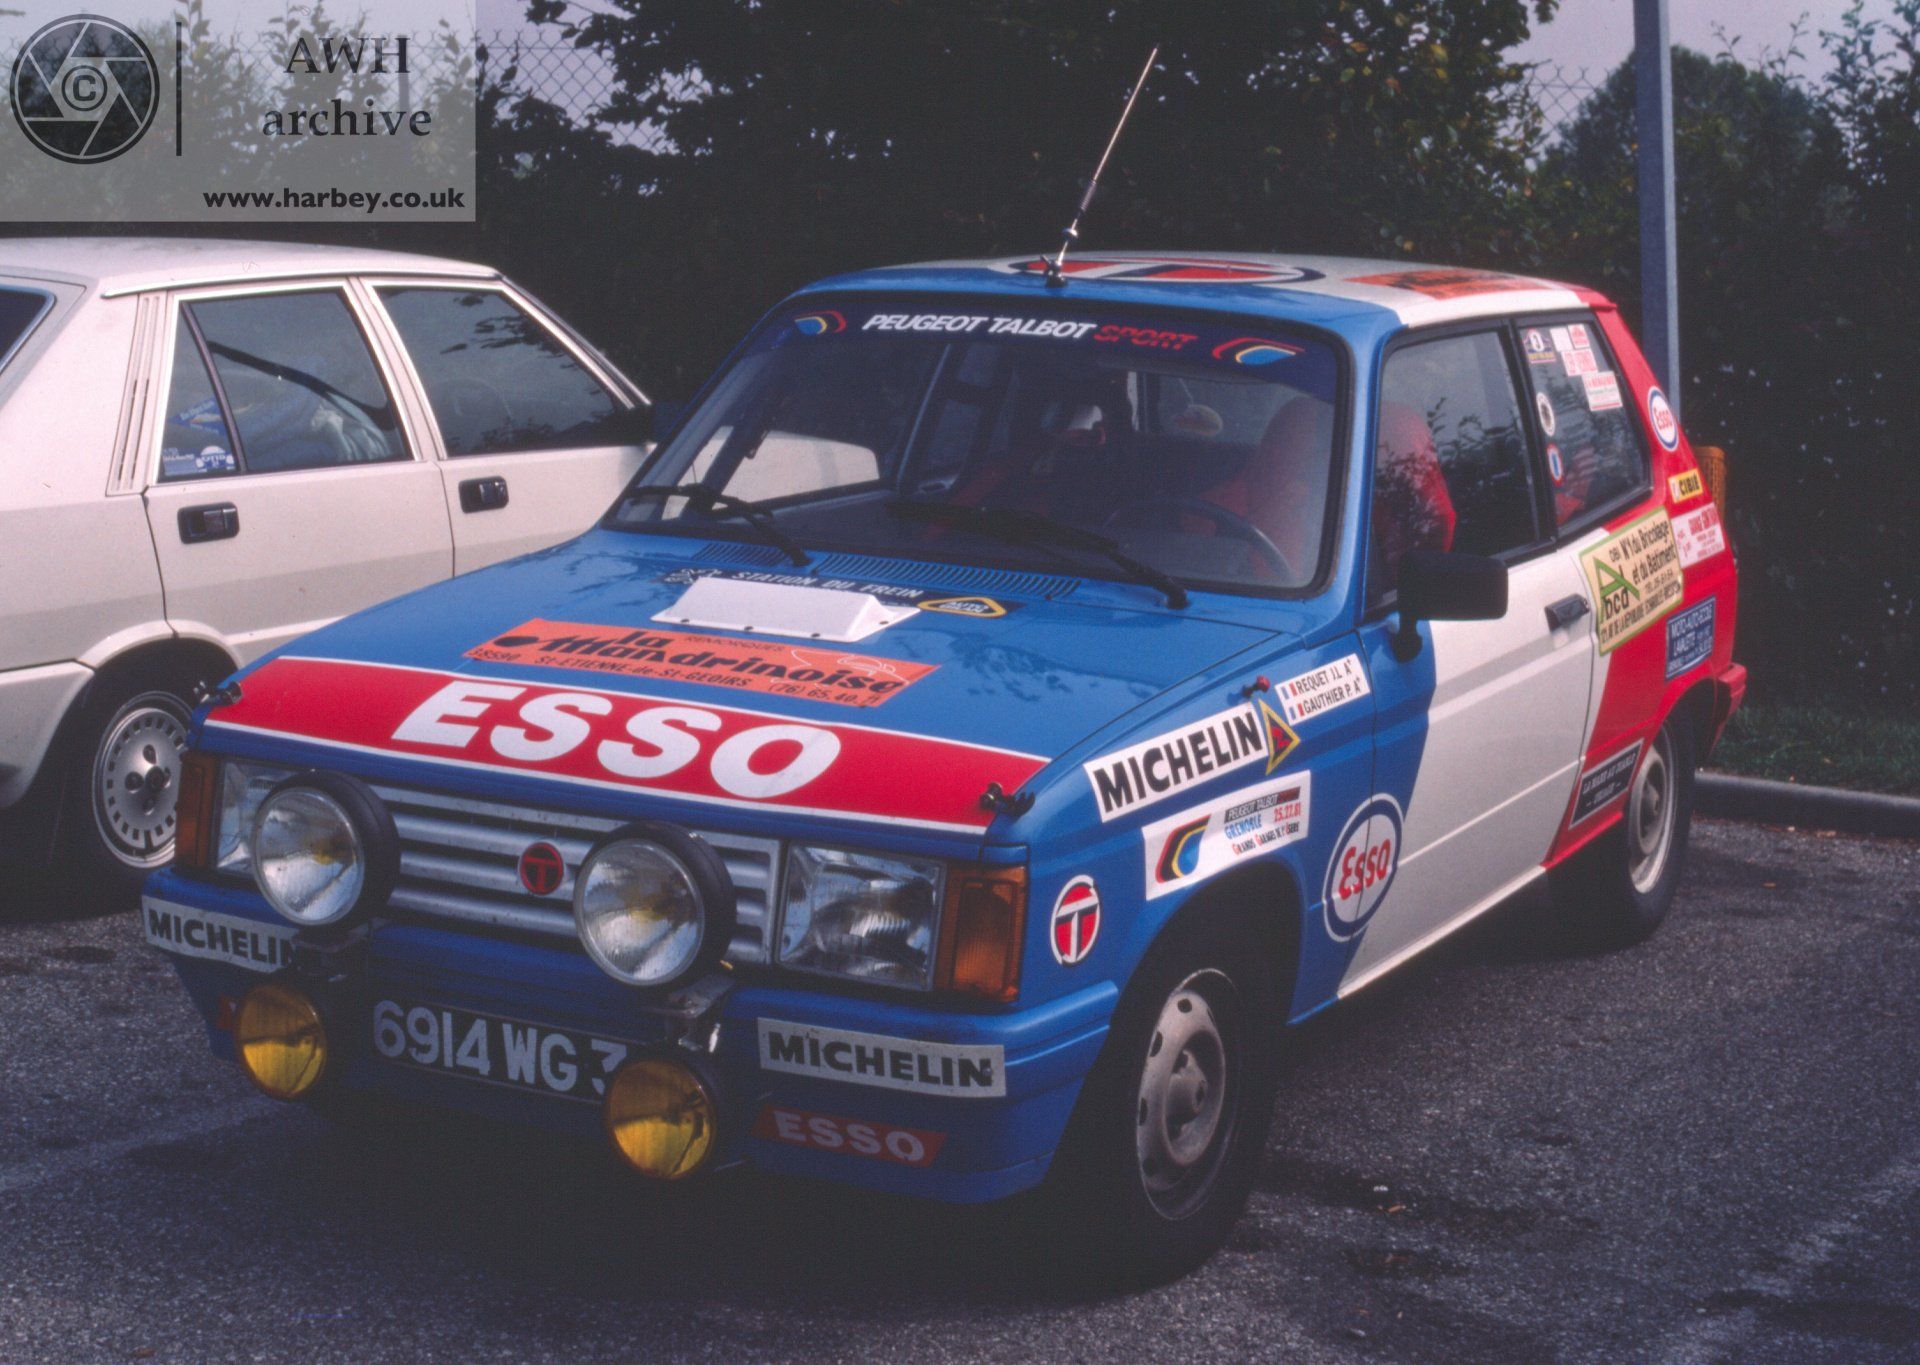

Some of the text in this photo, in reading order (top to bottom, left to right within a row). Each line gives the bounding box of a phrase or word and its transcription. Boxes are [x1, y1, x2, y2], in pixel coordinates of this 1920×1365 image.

[862, 313, 1198, 350] PEUGEOT TALBOT SPORT
[731, 571, 814, 586] STATION
[823, 579, 851, 589] DU
[860, 582, 924, 599] FREIN
[615, 631, 675, 648] la
[768, 683, 806, 695] (76)
[1295, 670, 1330, 695] REQUET
[1303, 687, 1345, 714] GAUTHIER
[392, 681, 841, 799] ESSO
[1094, 711, 1263, 813] MICHELIN
[1225, 814, 1262, 840] GRENOBLE
[373, 1000, 491, 1077] 6914
[503, 1022, 579, 1091] WG
[768, 1030, 994, 1088] MICHELIN
[773, 1110, 925, 1162] ESSO
